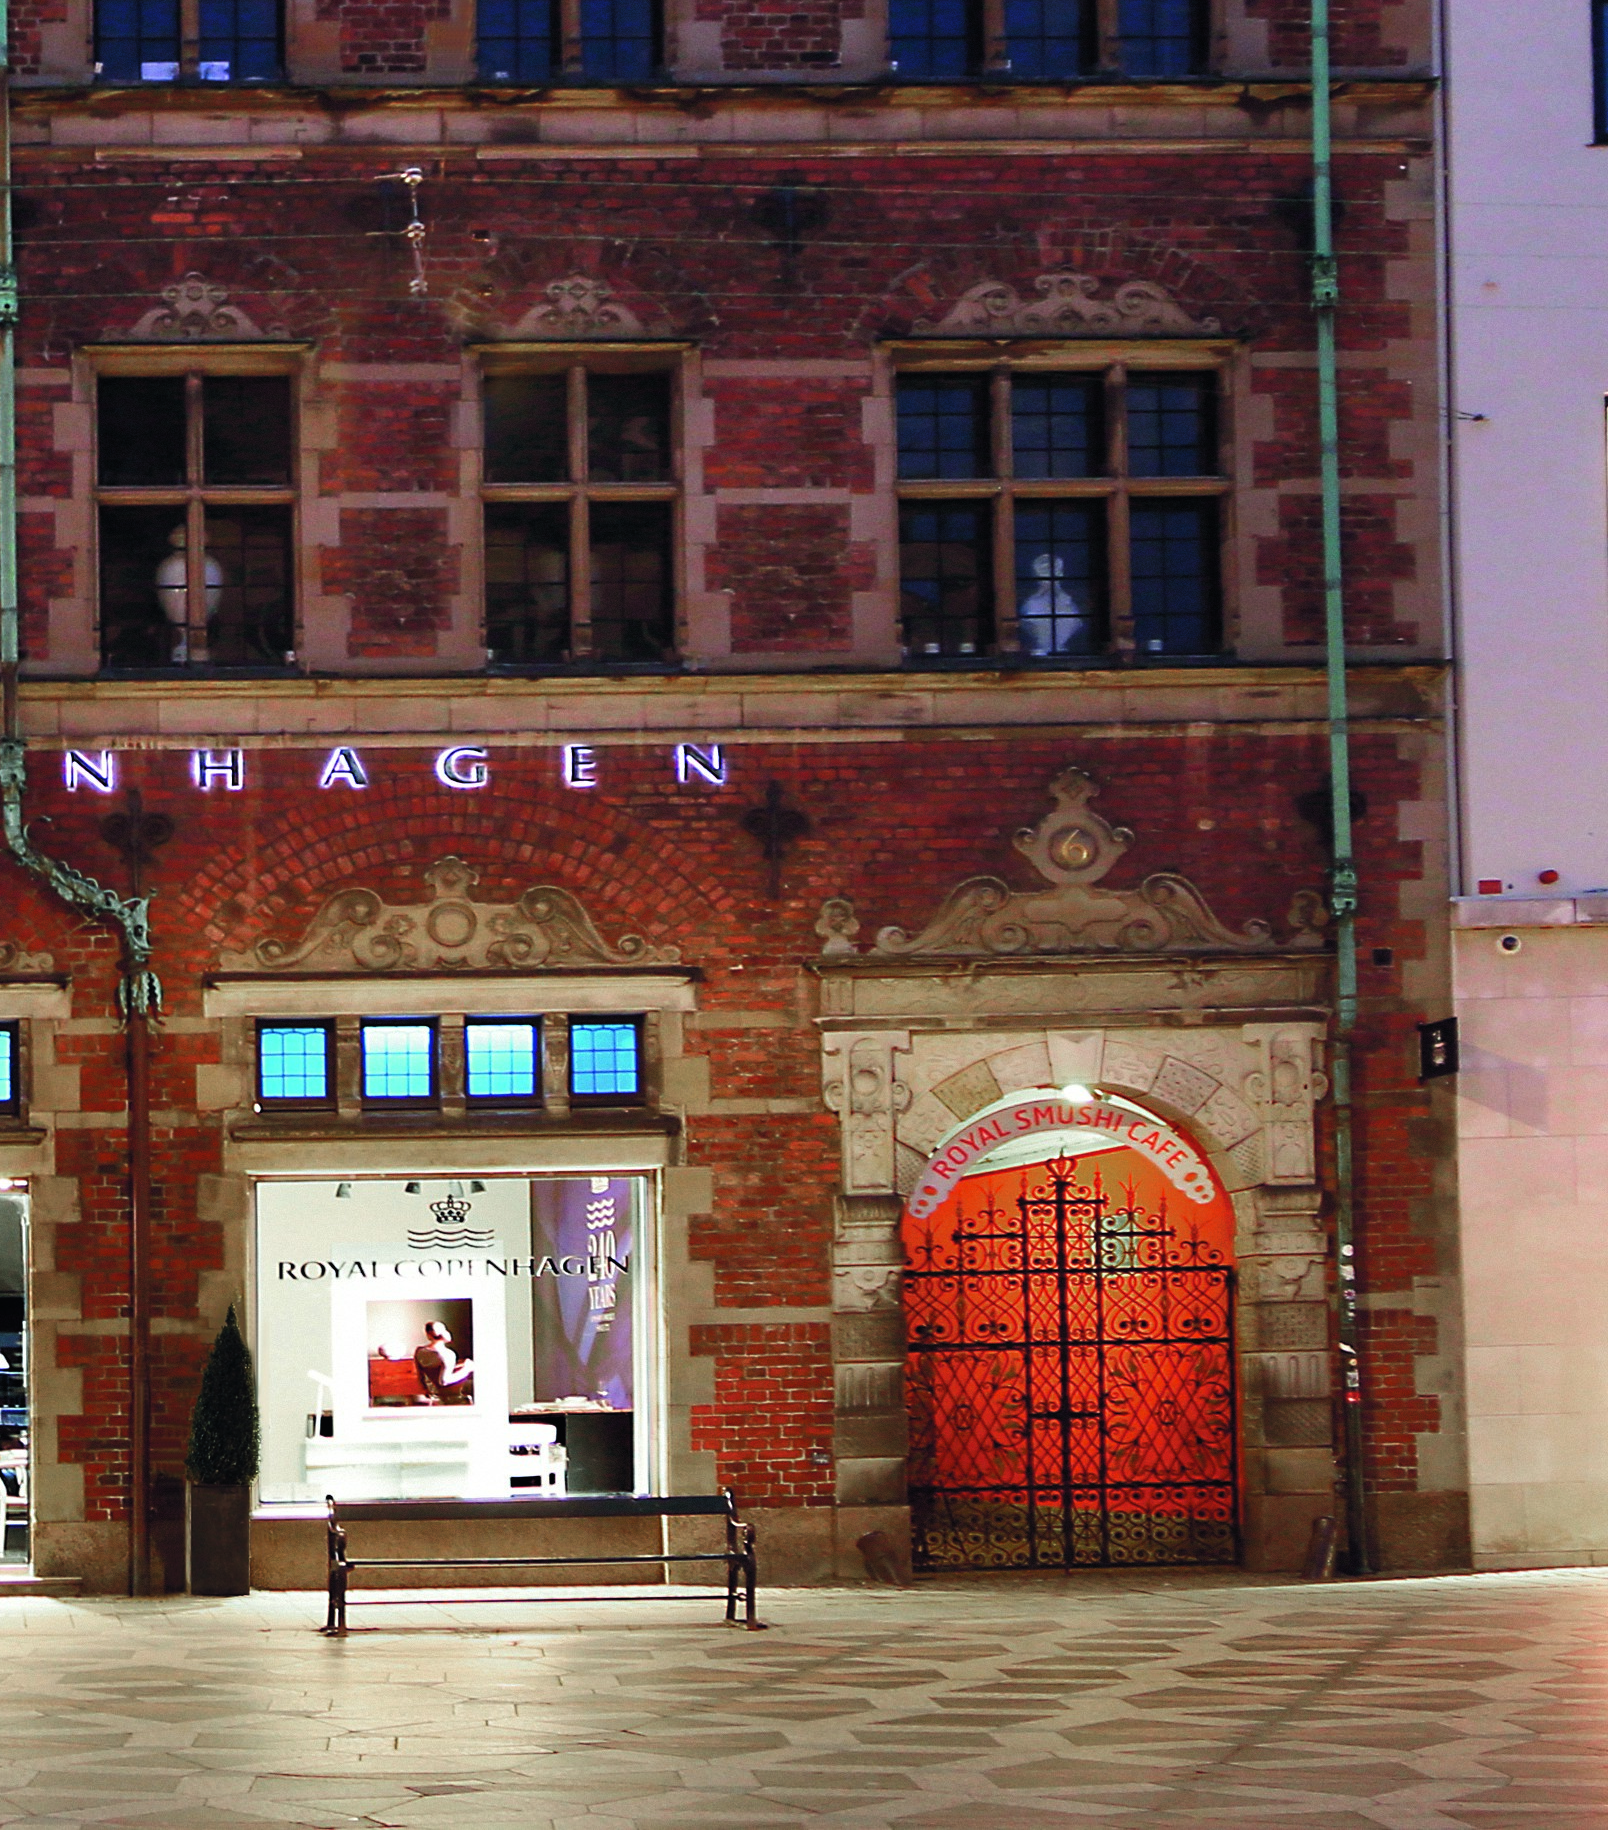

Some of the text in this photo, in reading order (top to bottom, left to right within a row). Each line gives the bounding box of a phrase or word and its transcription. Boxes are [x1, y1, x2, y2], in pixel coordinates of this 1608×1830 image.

[1061, 829, 1089, 865] 6
[932, 1105, 1187, 1180] ROYAL SMUSHI CAFE
[278, 1255, 629, 1281] ROYAL COPENHAGEN
